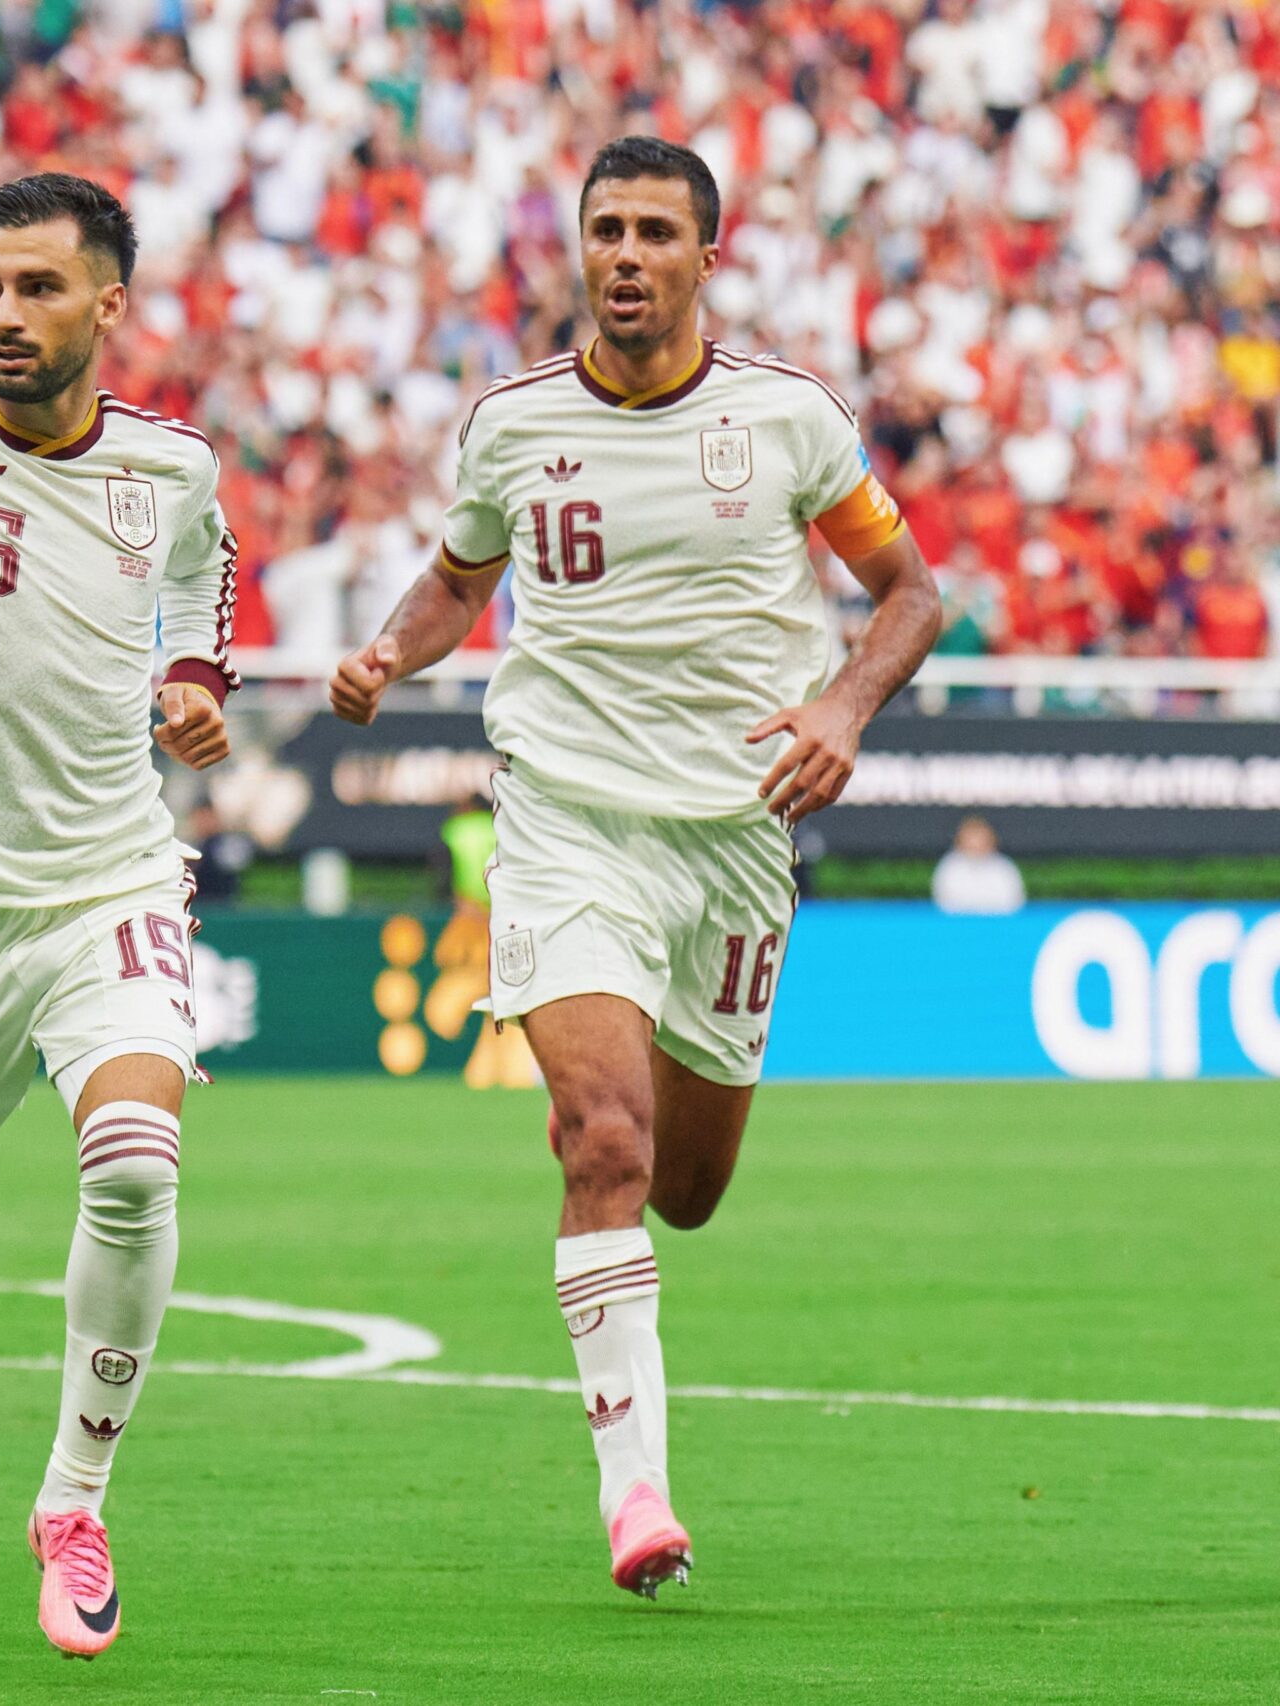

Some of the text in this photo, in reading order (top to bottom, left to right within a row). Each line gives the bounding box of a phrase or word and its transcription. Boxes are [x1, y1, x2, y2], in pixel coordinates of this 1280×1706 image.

[529, 501, 605, 585] 16
[115, 912, 190, 989] 15
[711, 932, 778, 1016] 16
